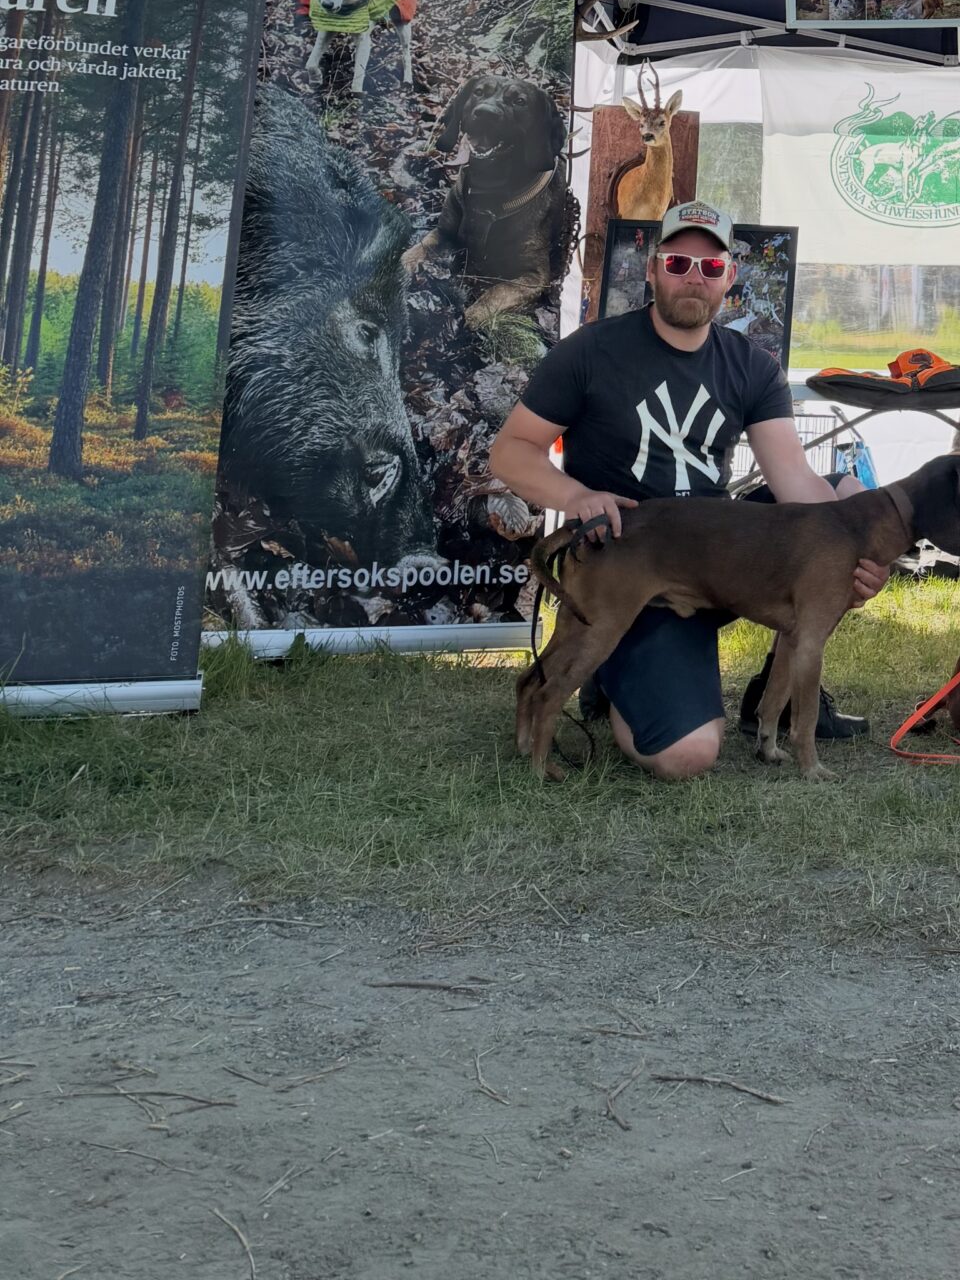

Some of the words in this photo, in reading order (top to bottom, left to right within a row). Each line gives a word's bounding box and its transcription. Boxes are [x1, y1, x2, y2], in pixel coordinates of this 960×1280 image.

[133, 44, 190, 61] verkar
[28, 56, 61, 72] och
[64, 58, 118, 77] vårda
[120, 62, 183, 83] jakten,
[839, 155, 867, 205] SVENSKA
[205, 560, 529, 593] www.eftersokspoolen.se
[173, 585, 185, 637] MOSTPHOTOS
